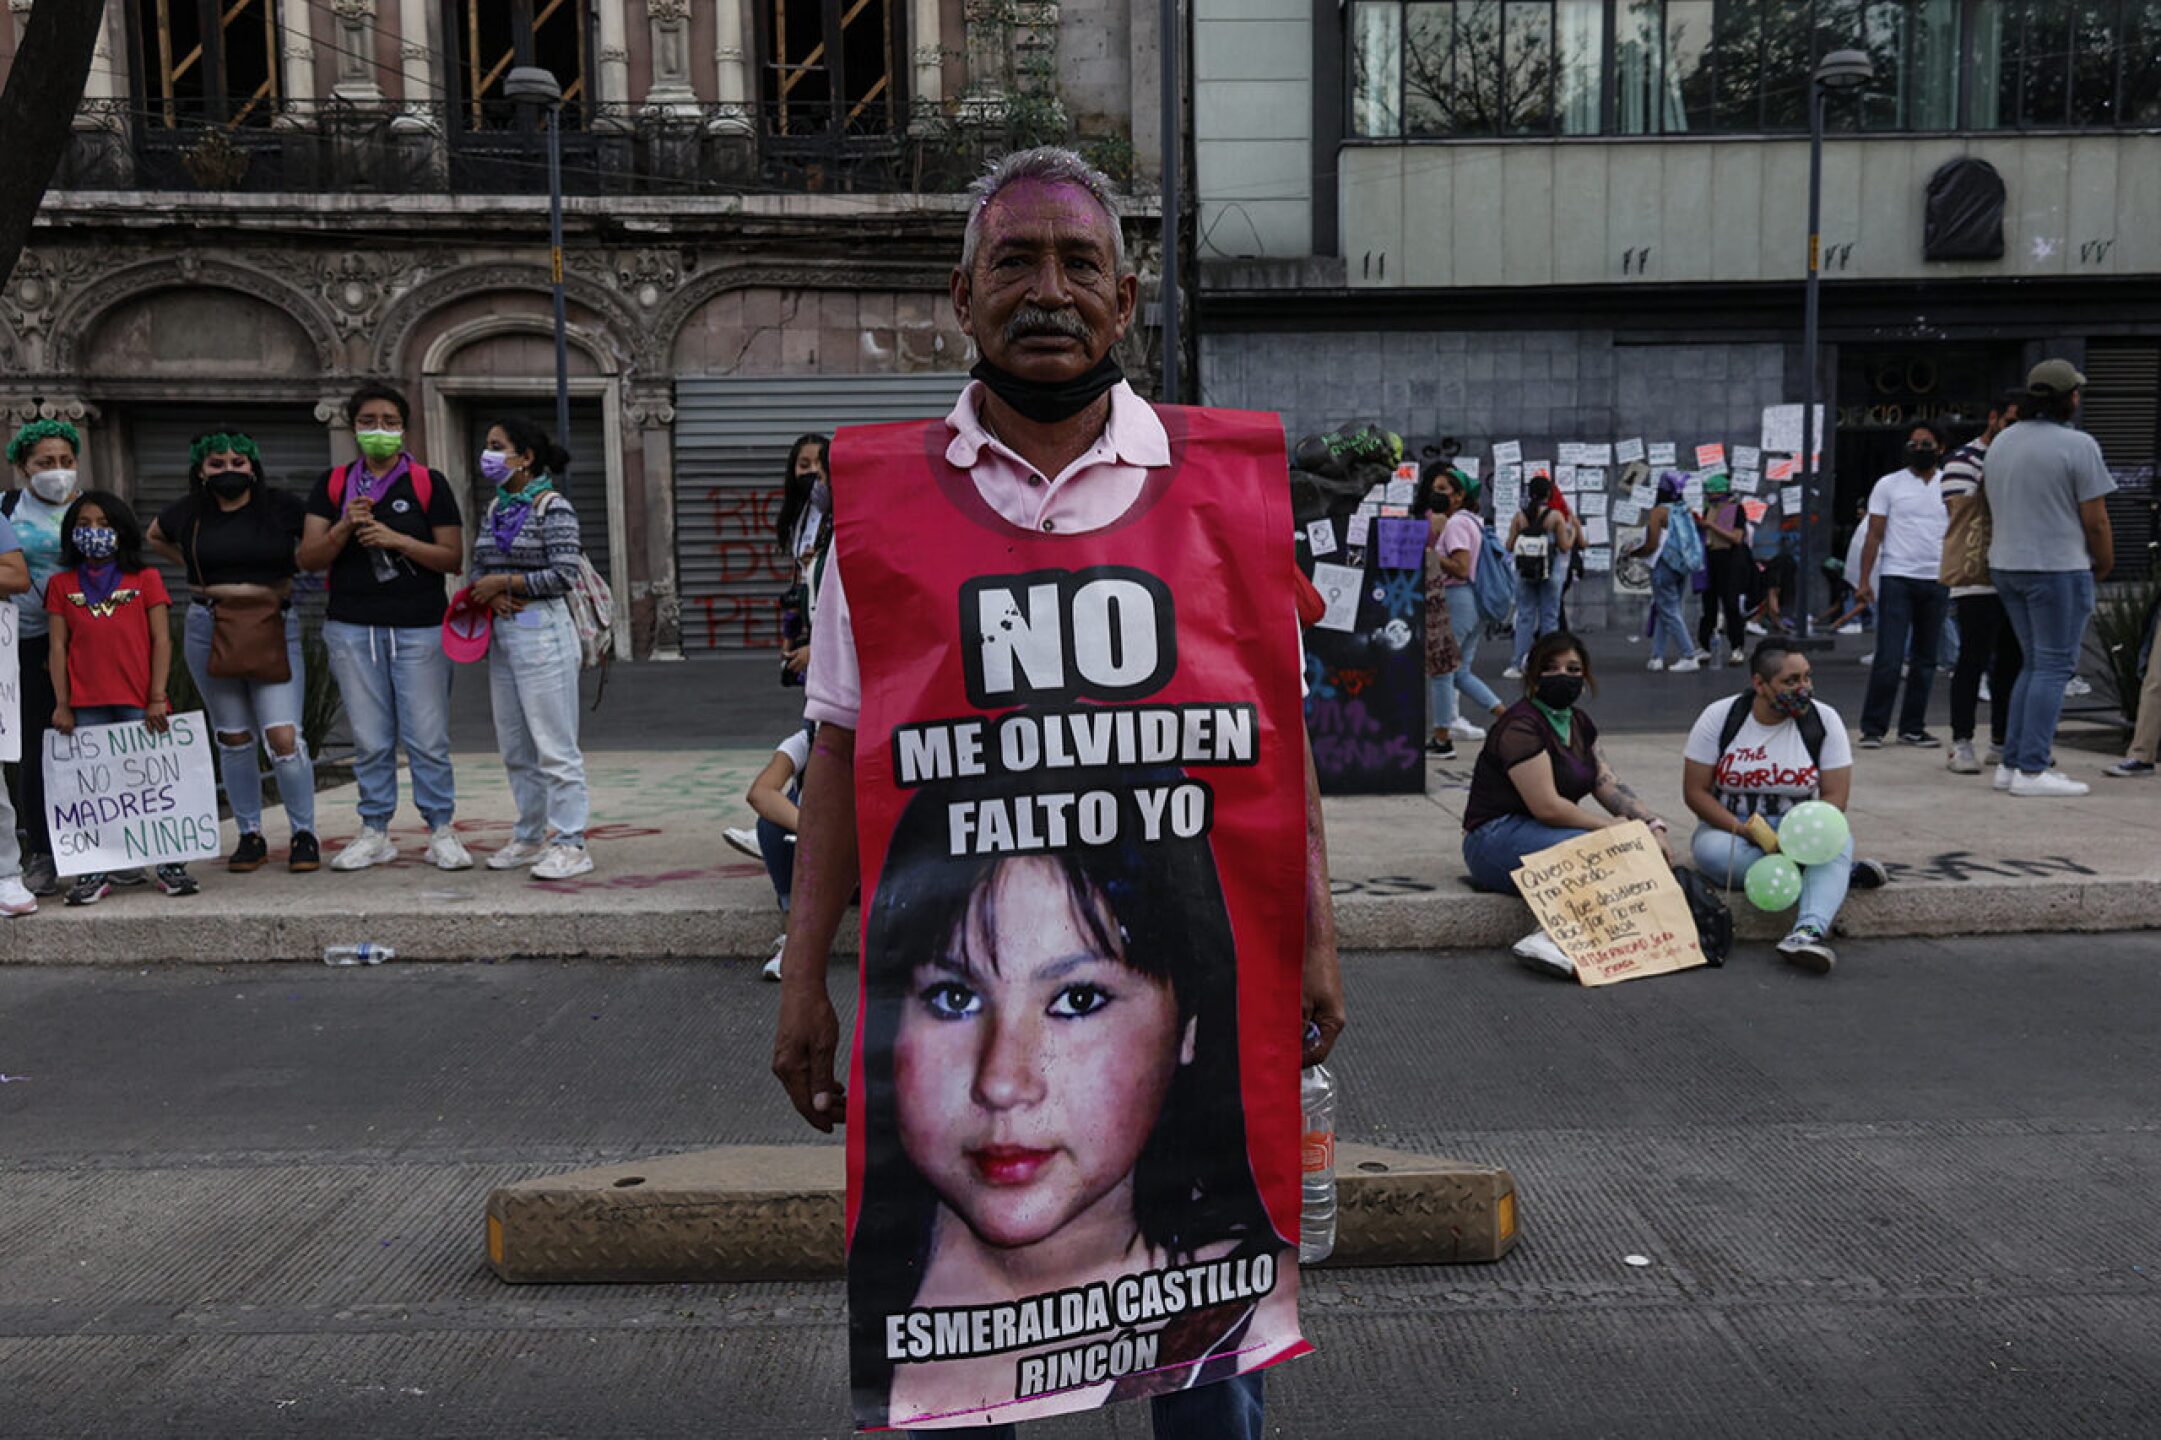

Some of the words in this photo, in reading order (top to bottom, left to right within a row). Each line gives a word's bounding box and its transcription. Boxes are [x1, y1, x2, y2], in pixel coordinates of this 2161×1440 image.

[979, 578, 1158, 695] NO
[51, 731, 101, 761] LAS
[77, 764, 110, 794] NO
[124, 753, 181, 789] SON
[898, 721, 986, 783] ME
[1000, 708, 1252, 771] OLVIDEN
[54, 785, 176, 830] MADRES
[59, 828, 100, 856] SON
[124, 812, 217, 860] NIÑAS
[948, 790, 1118, 856] FALTO
[1134, 784, 1205, 842] YO
[886, 1287, 1110, 1360] ESMERALDA
[1116, 1253, 1275, 1324] CASTILLO
[1020, 1328, 1159, 1397] RINCÓN
